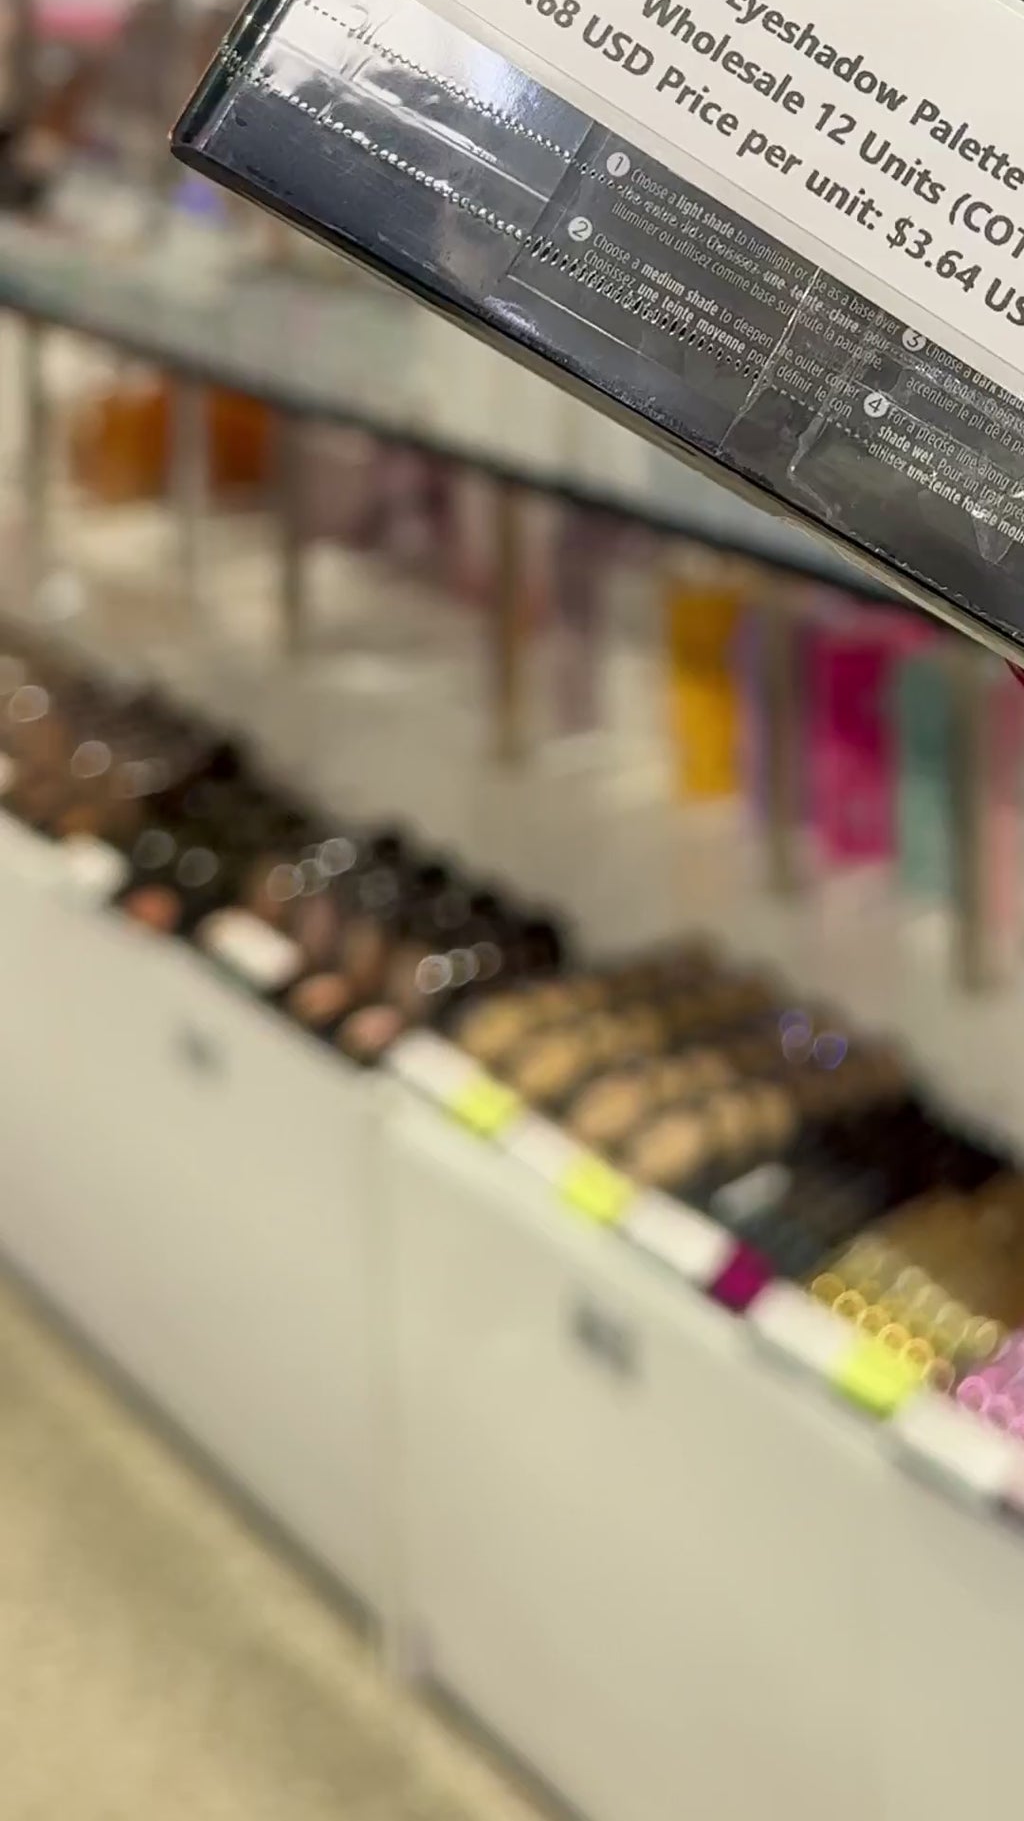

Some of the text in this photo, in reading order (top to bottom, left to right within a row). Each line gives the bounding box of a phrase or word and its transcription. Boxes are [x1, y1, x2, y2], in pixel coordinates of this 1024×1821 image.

[582, 15, 654, 76] USD
[656, 66, 739, 137] Price
[736, 129, 802, 176] per
[805, 165, 883, 231] unit:
[886, 215, 982, 293] $3.64
[814, 102, 857, 146] 12
[859, 130, 945, 205] Units
[610, 198, 778, 307] illuminer ou utilisez comme base
[628, 166, 671, 201] Choose
[673, 193, 705, 222] light
[700, 209, 737, 240] shade
[732, 229, 749, 247] to
[743, 234, 797, 277] highlight
[825, 284, 843, 301] as
[847, 296, 877, 322] base
[581, 247, 637, 290] Choisissez
[635, 281, 661, 304] une
[659, 293, 697, 325] teinte
[693, 315, 747, 357] moyenne
[591, 230, 633, 265] Choose
[639, 259, 687, 297] medium
[683, 285, 721, 317] shade
[717, 307, 734, 325] to
[730, 314, 776, 351] deepen
[792, 350, 826, 379] outer
[875, 422, 913, 454] shade
[904, 373, 959, 415] accentuer
